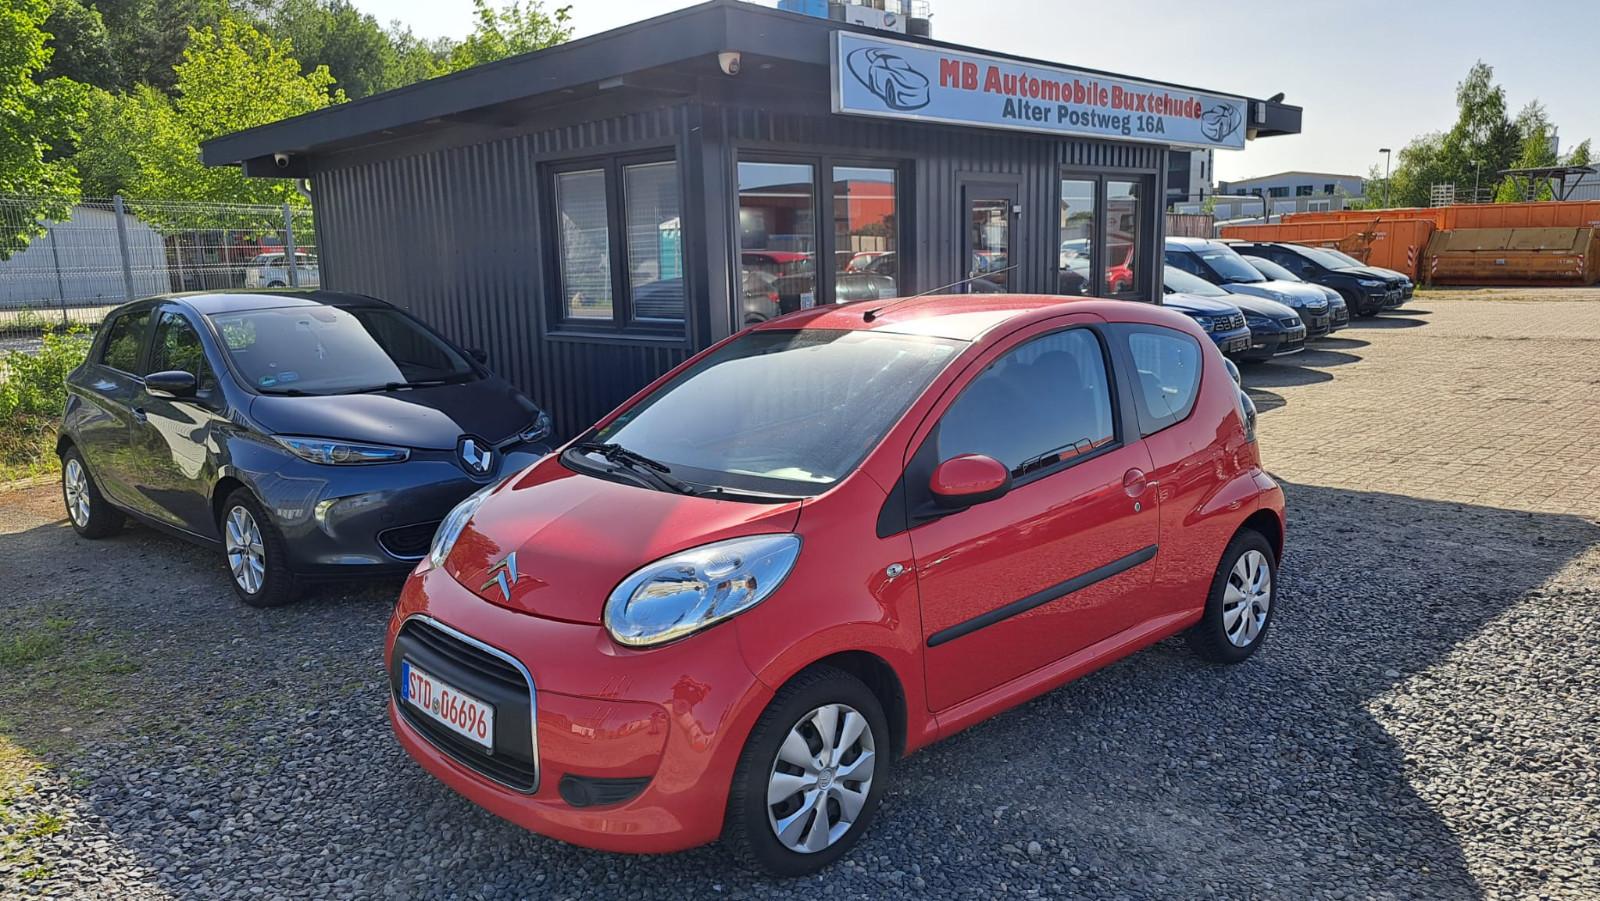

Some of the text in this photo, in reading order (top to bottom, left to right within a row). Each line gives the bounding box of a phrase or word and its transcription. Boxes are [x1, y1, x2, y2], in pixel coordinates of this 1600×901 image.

[940, 58, 1202, 120] MB Automobile Buxtehude
[1002, 98, 1166, 136] Alter Postweg 16A
[409, 671, 487, 739] STD 06696
